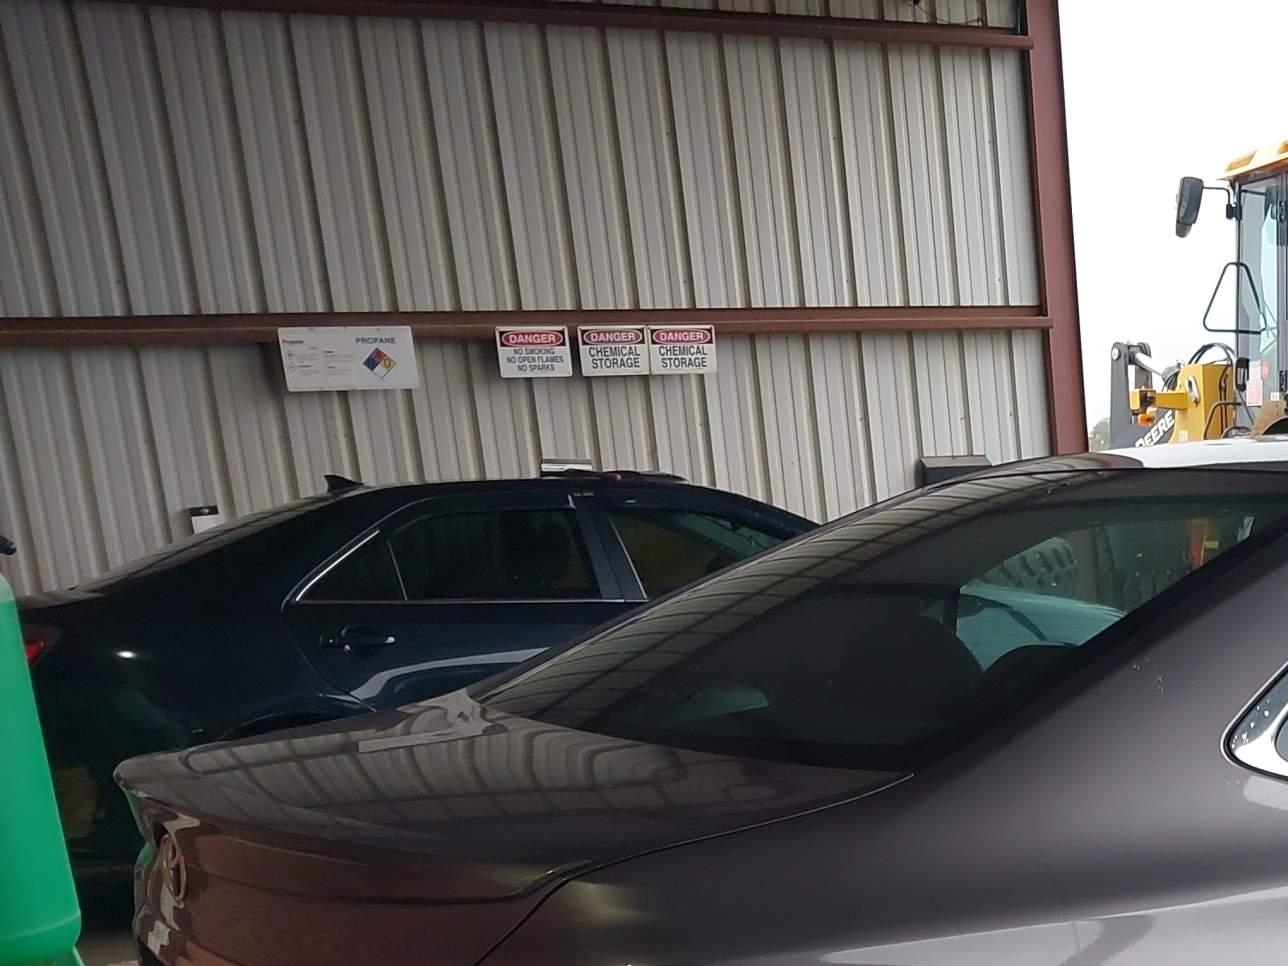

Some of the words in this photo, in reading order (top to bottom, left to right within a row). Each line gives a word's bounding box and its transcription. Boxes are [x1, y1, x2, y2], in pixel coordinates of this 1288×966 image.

[509, 335, 556, 343] DANGER
[590, 332, 636, 341] DANGER
[660, 331, 704, 340] DANGER
[588, 346, 640, 357] CHEMICAL
[659, 345, 707, 356] CHEMICAL
[537, 355, 563, 363] FLAMES
[592, 358, 640, 369] STORAGE
[662, 357, 708, 368] STORAGE
[1134, 409, 1175, 448] DEERE
